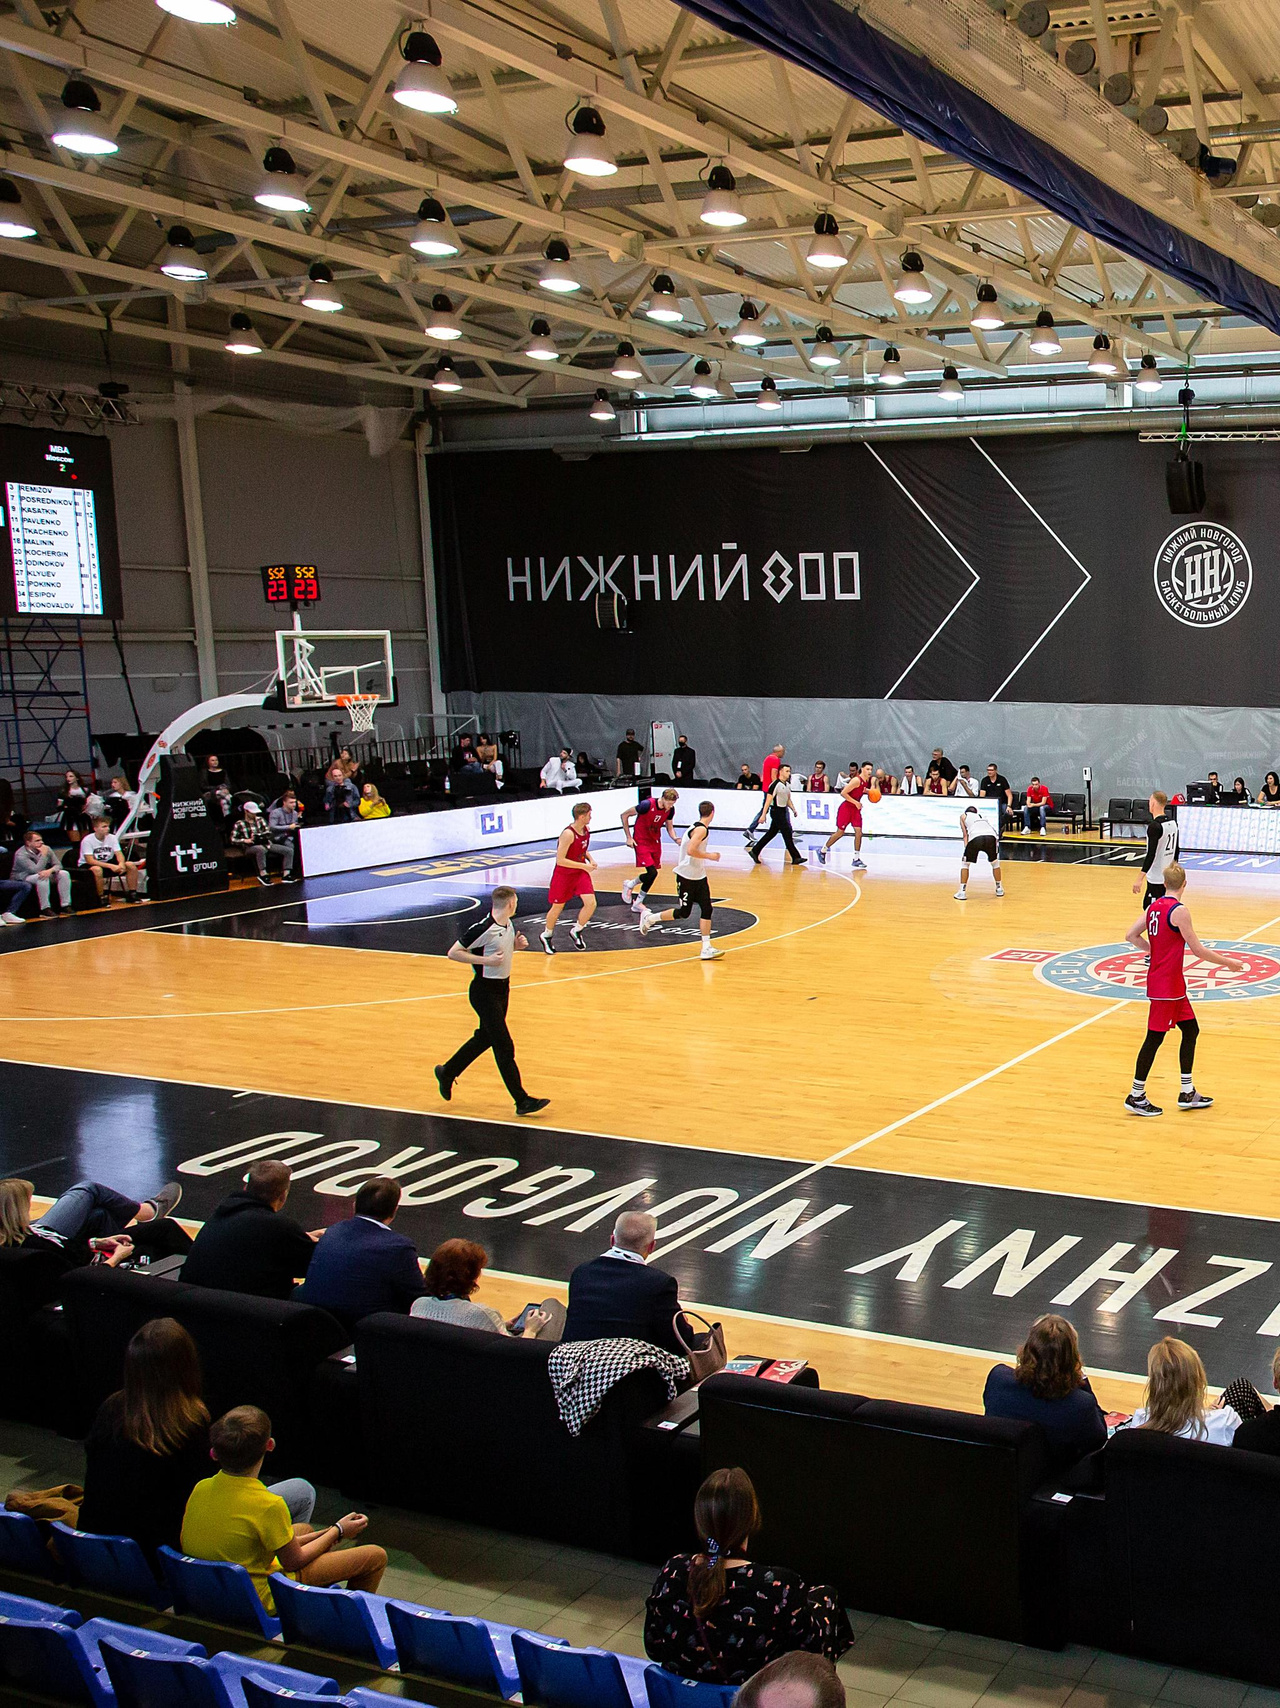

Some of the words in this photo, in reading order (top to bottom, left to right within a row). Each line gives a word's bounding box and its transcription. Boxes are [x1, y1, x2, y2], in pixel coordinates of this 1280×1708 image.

[49, 445, 70, 454] MBA
[59, 464, 66, 472] 2
[20, 485, 52, 493] REMIZOV
[21, 496, 73, 506] POSREDNIKOV
[21, 507, 57, 515] KASATKIN
[23, 517, 61, 526] PAVLENKO
[24, 528, 68, 537] TKACHENKO
[1162, 527, 1197, 563] НИЖНИЙ
[1201, 528, 1244, 564] НОВГОРОД
[26, 549, 68, 557] KOCHERGIN
[507, 543, 750, 601] НИЖНИЙ
[762, 551, 861, 603] 800
[1184, 548, 1221, 601] НН
[268, 580, 287, 600] 23
[294, 579, 317, 599] 23
[1161, 580, 1230, 621] БАСКЕТБОЛЬНЫЙ
[1228, 580, 1246, 606] КЛУБ
[172, 798, 203, 807] НИЖНИЙ
[173, 805, 206, 813] НОВГОРОД
[1165, 832, 1175, 851] 21
[193, 861, 218, 873] group
[682, 892, 688, 901] 2
[1149, 911, 1160, 936] 25
[1002, 951, 1048, 960] 20
[1051, 953, 1113, 991] КУБОК
[177, 1131, 854, 1260] NOVGOROD
